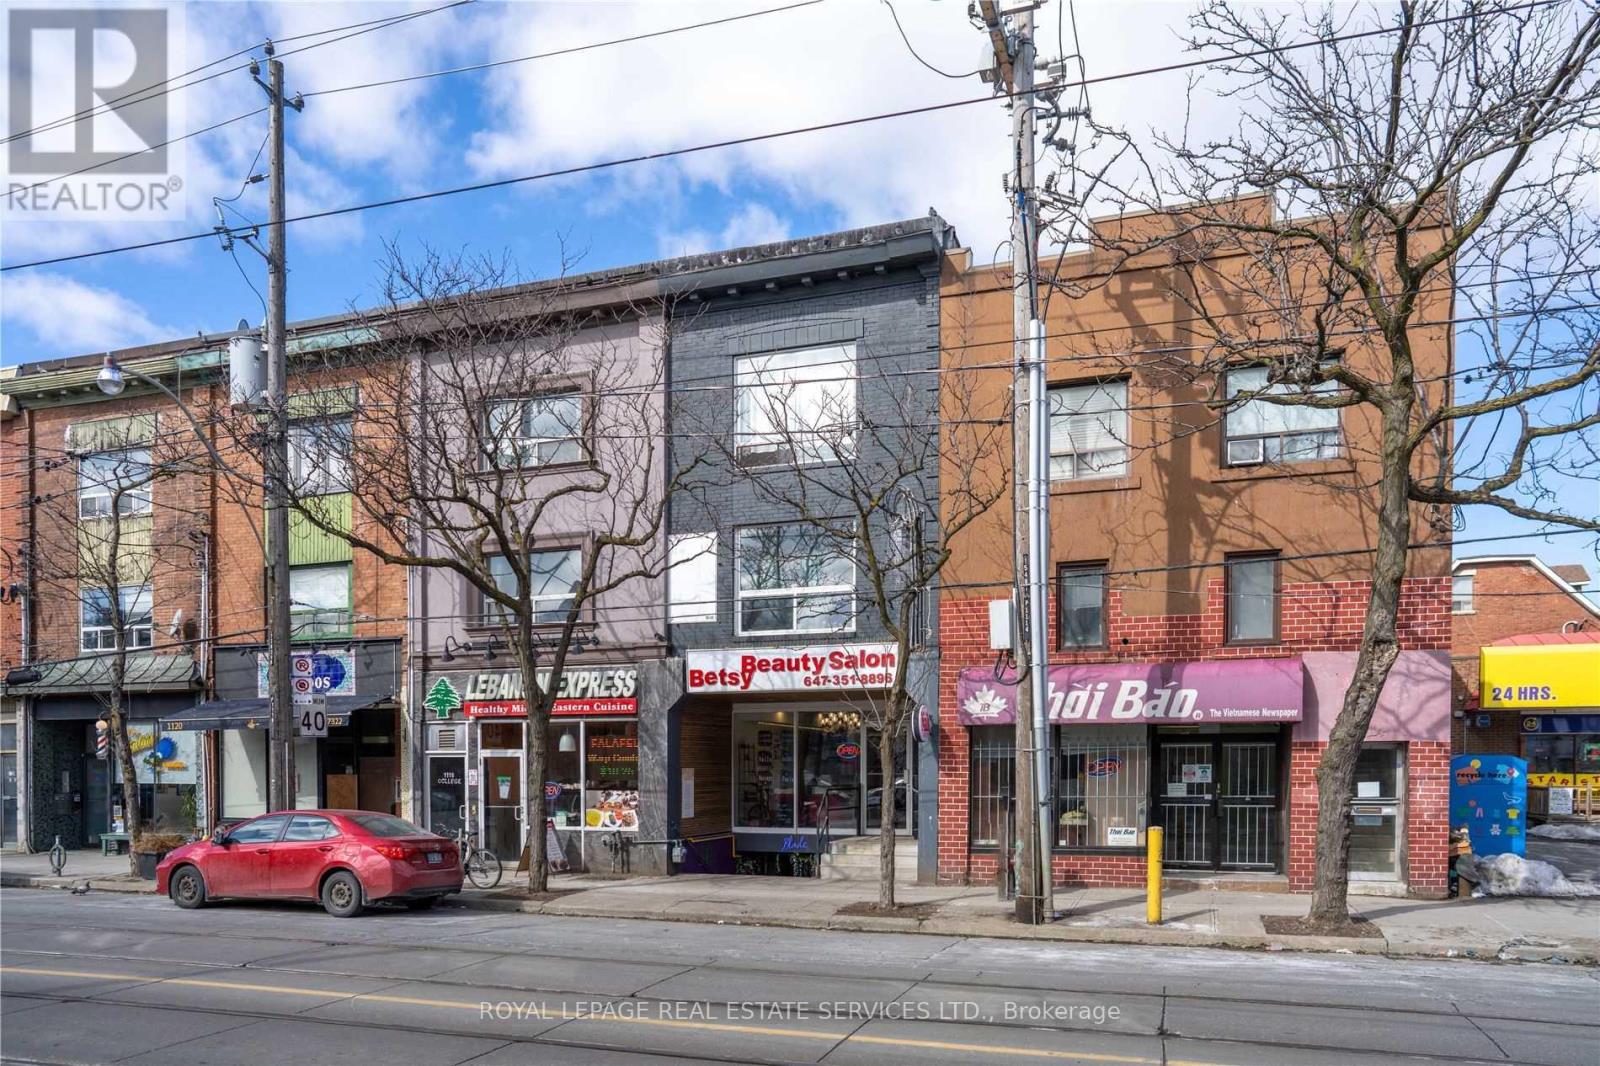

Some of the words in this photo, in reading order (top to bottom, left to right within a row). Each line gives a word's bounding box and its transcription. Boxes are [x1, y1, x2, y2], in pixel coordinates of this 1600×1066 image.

[689, 668, 754, 690] Betsy
[741, 653, 826, 676] Beauty
[829, 649, 896, 670] Salon
[465, 672, 551, 700] LEBANN
[556, 669, 637, 699] EXPRESS
[1492, 686, 1513, 701] 24
[1518, 685, 1556, 701] HRS.
[470, 704, 508, 715] Healthy
[594, 701, 634, 712] Cuisine
[1047, 681, 1109, 720] hời
[301, 711, 326, 731] 40
[1209, 708, 1222, 717] The
[1223, 708, 1260, 717] Vietnamese
[1262, 707, 1298, 719] Newspaper
[167, 722, 183, 730] 1120
